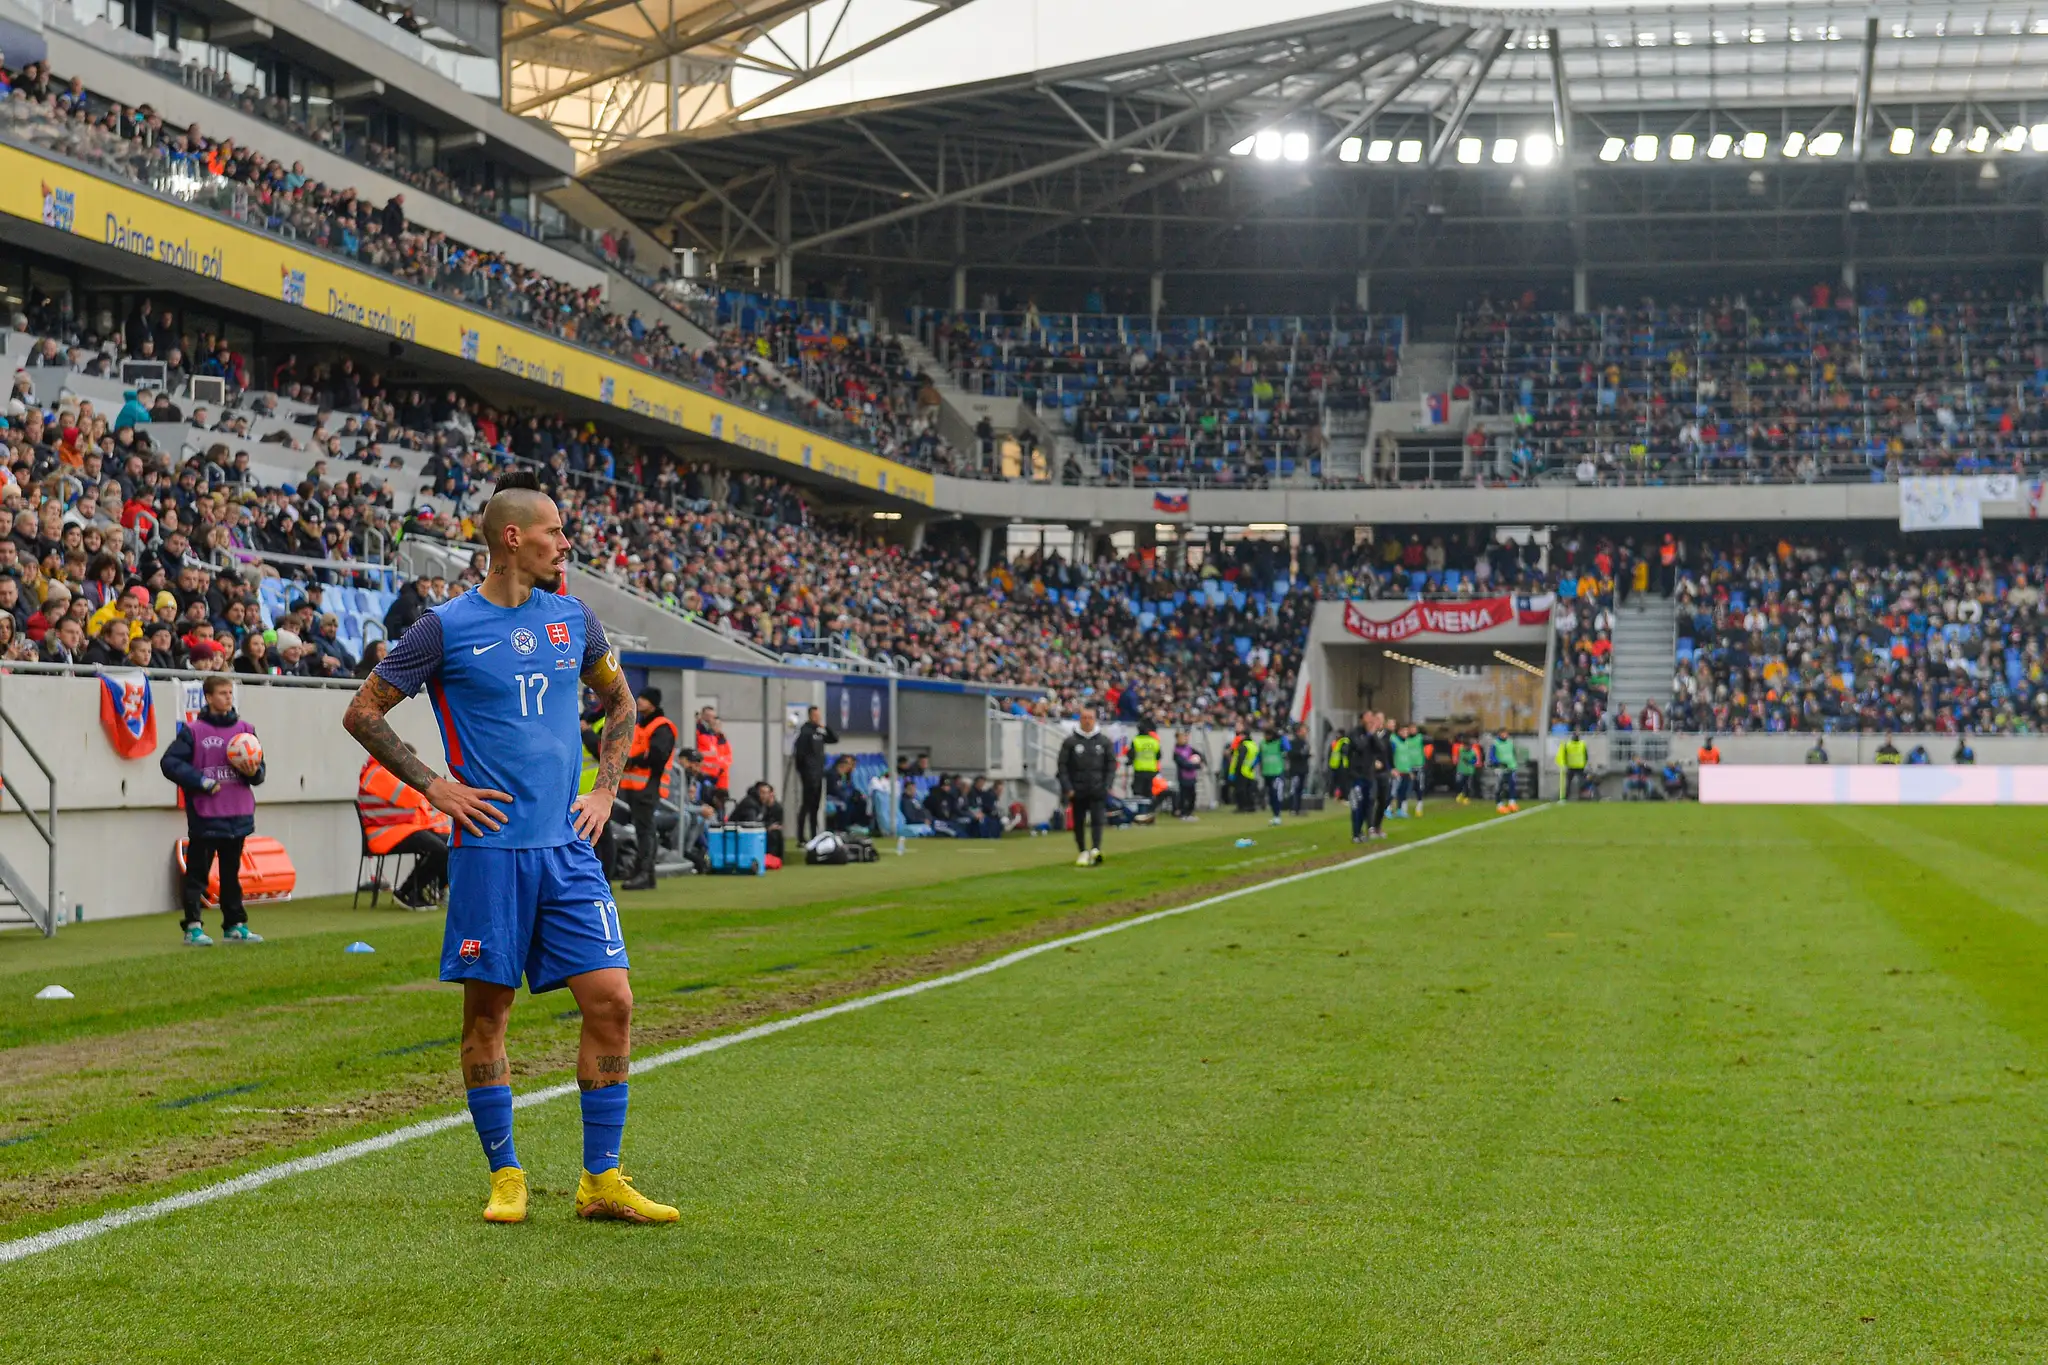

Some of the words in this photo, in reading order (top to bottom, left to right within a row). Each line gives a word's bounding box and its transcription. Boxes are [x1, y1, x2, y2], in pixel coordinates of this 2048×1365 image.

[1423, 607, 1493, 632] VIENA
[514, 673, 549, 717] 17
[593, 900, 623, 941] 17
